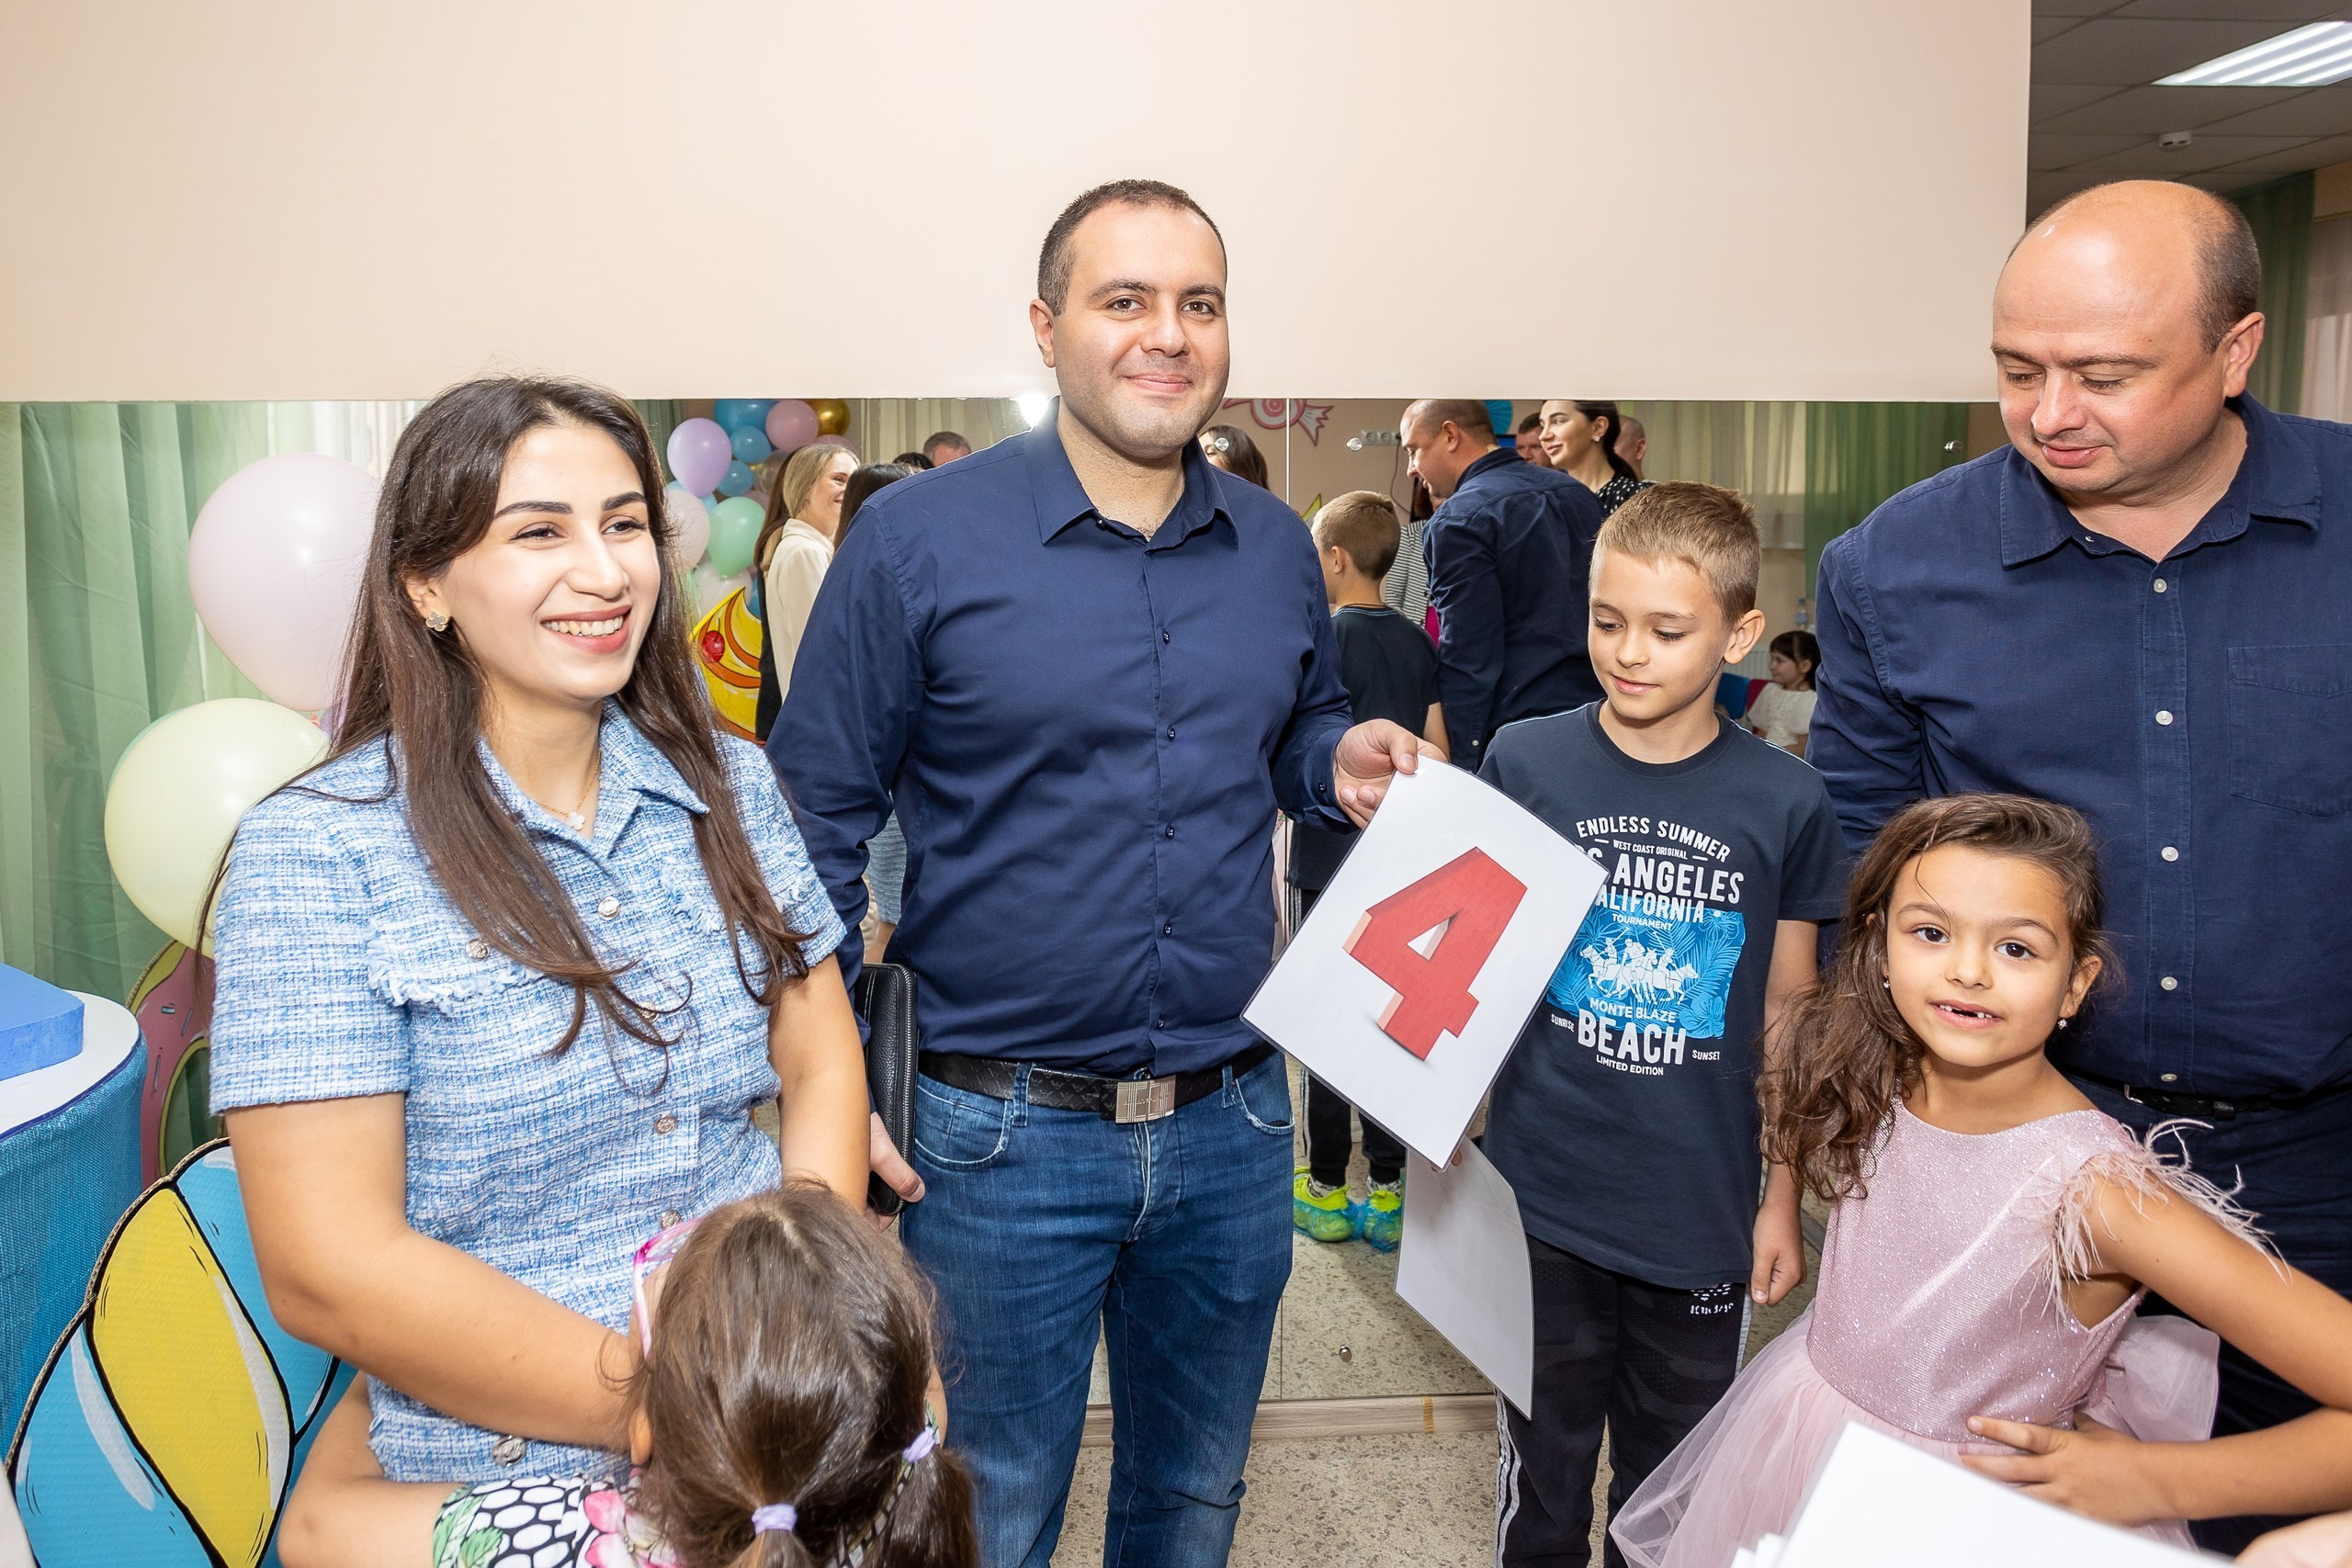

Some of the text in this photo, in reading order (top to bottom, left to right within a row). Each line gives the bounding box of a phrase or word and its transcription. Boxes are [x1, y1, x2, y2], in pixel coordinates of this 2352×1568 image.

[1576, 816, 1731, 863] ENDLESS SUMMER
[1612, 839, 1689, 860] WEST COAST ORIGINAL
[1612, 852, 1745, 904] ANGELES
[1595, 884, 1704, 923] ALIFORNIA
[1611, 913, 1674, 931] TOURNAMENT
[1341, 846, 1528, 1061] 4
[1550, 1013, 1575, 1032] SUNRISE
[1589, 997, 1677, 1023] MONTE BLAZE
[1577, 1008, 1687, 1066] BEACH
[1596, 1054, 1664, 1076] LIMITED EDITION
[1691, 1049, 1721, 1061] SUNSET
